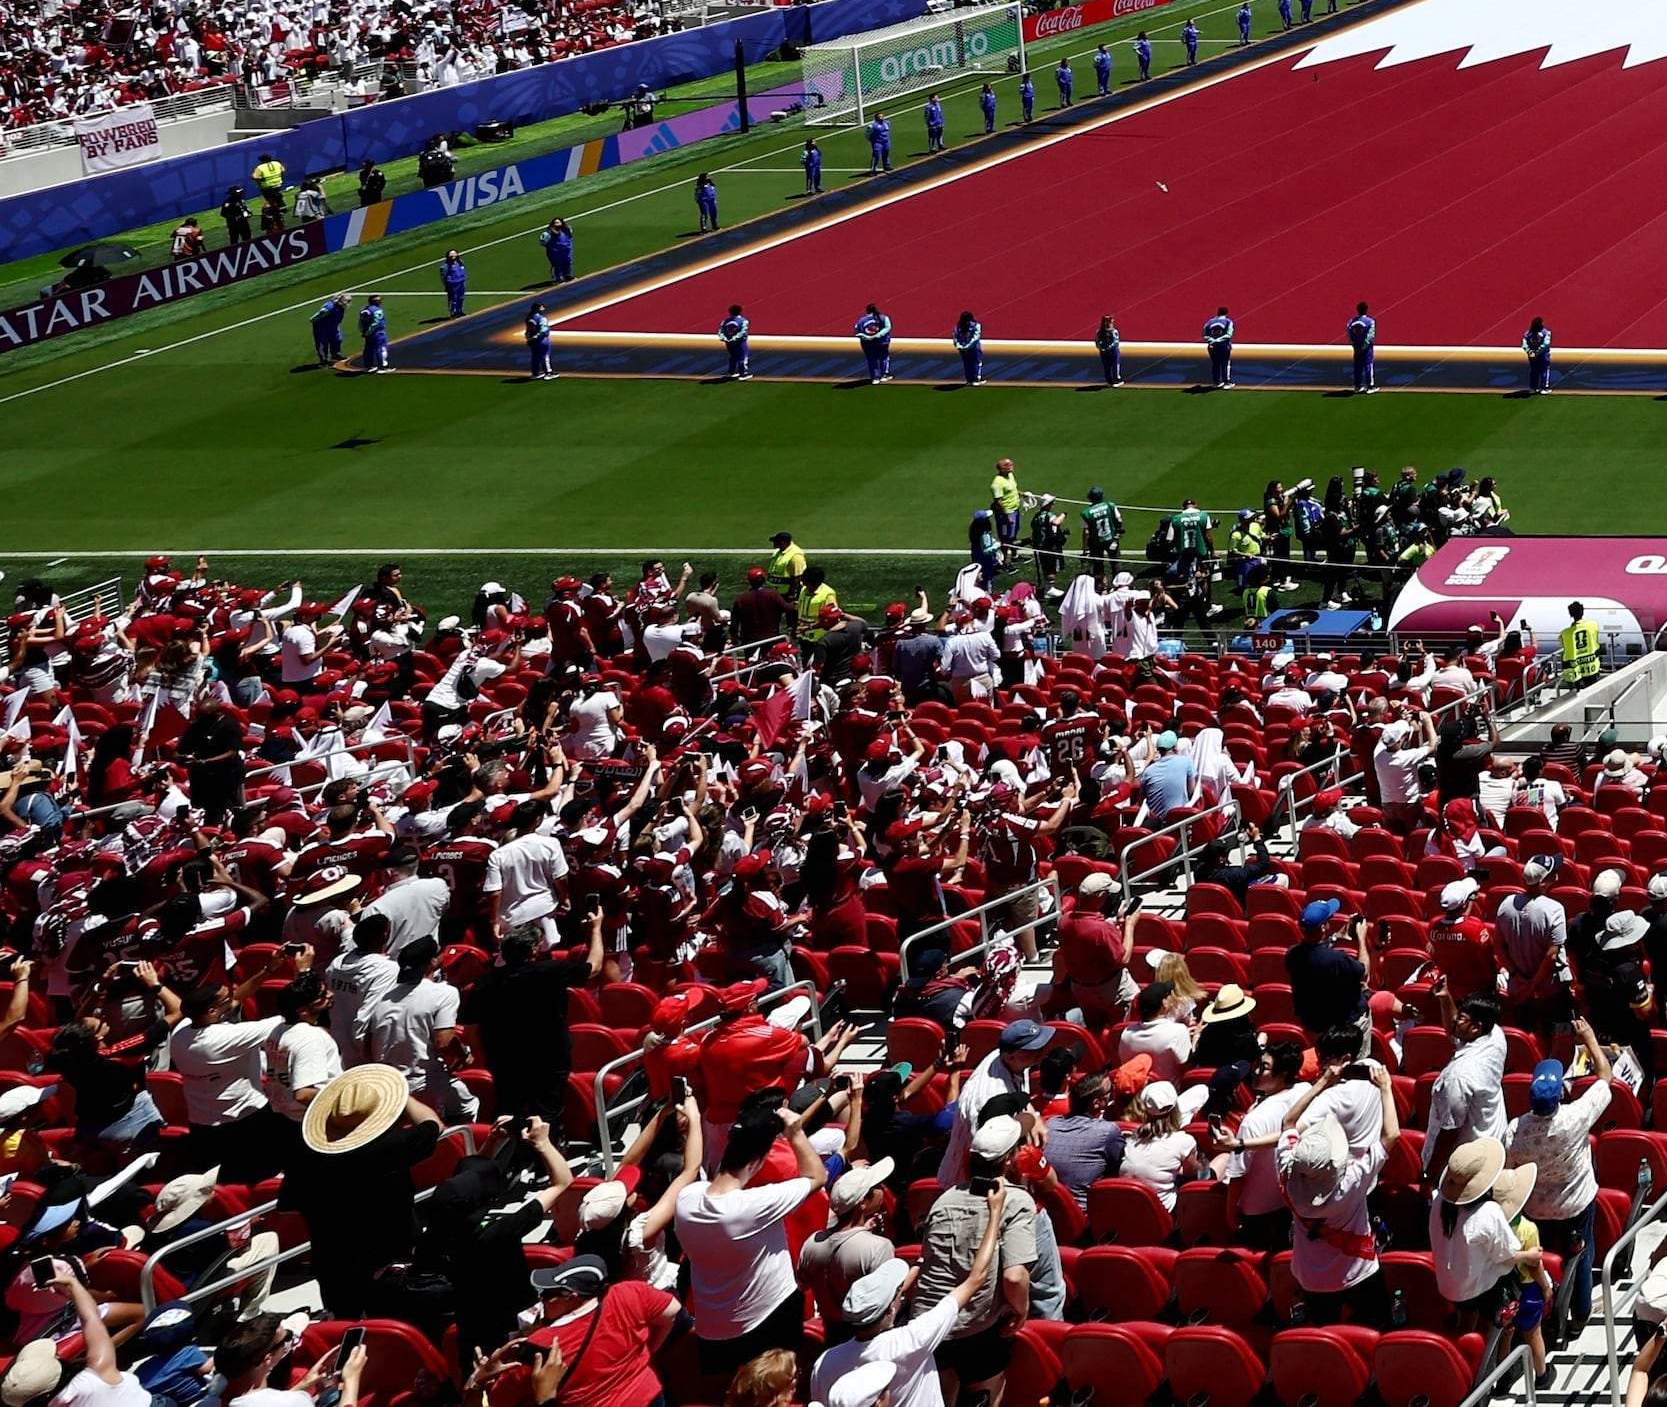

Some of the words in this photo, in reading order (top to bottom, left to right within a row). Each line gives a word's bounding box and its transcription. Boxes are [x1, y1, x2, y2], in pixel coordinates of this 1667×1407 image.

[1035, 5, 1085, 39] Coca-Cola
[880, 29, 988, 82] aramco
[76, 118, 157, 146] POWERED
[86, 144, 109, 159] BY
[114, 130, 160, 154] FANS
[430, 164, 526, 217] VISA
[133, 228, 310, 309] AIRWAYS
[1255, 637, 1277, 649] 140
[1057, 736, 1084, 763] 26
